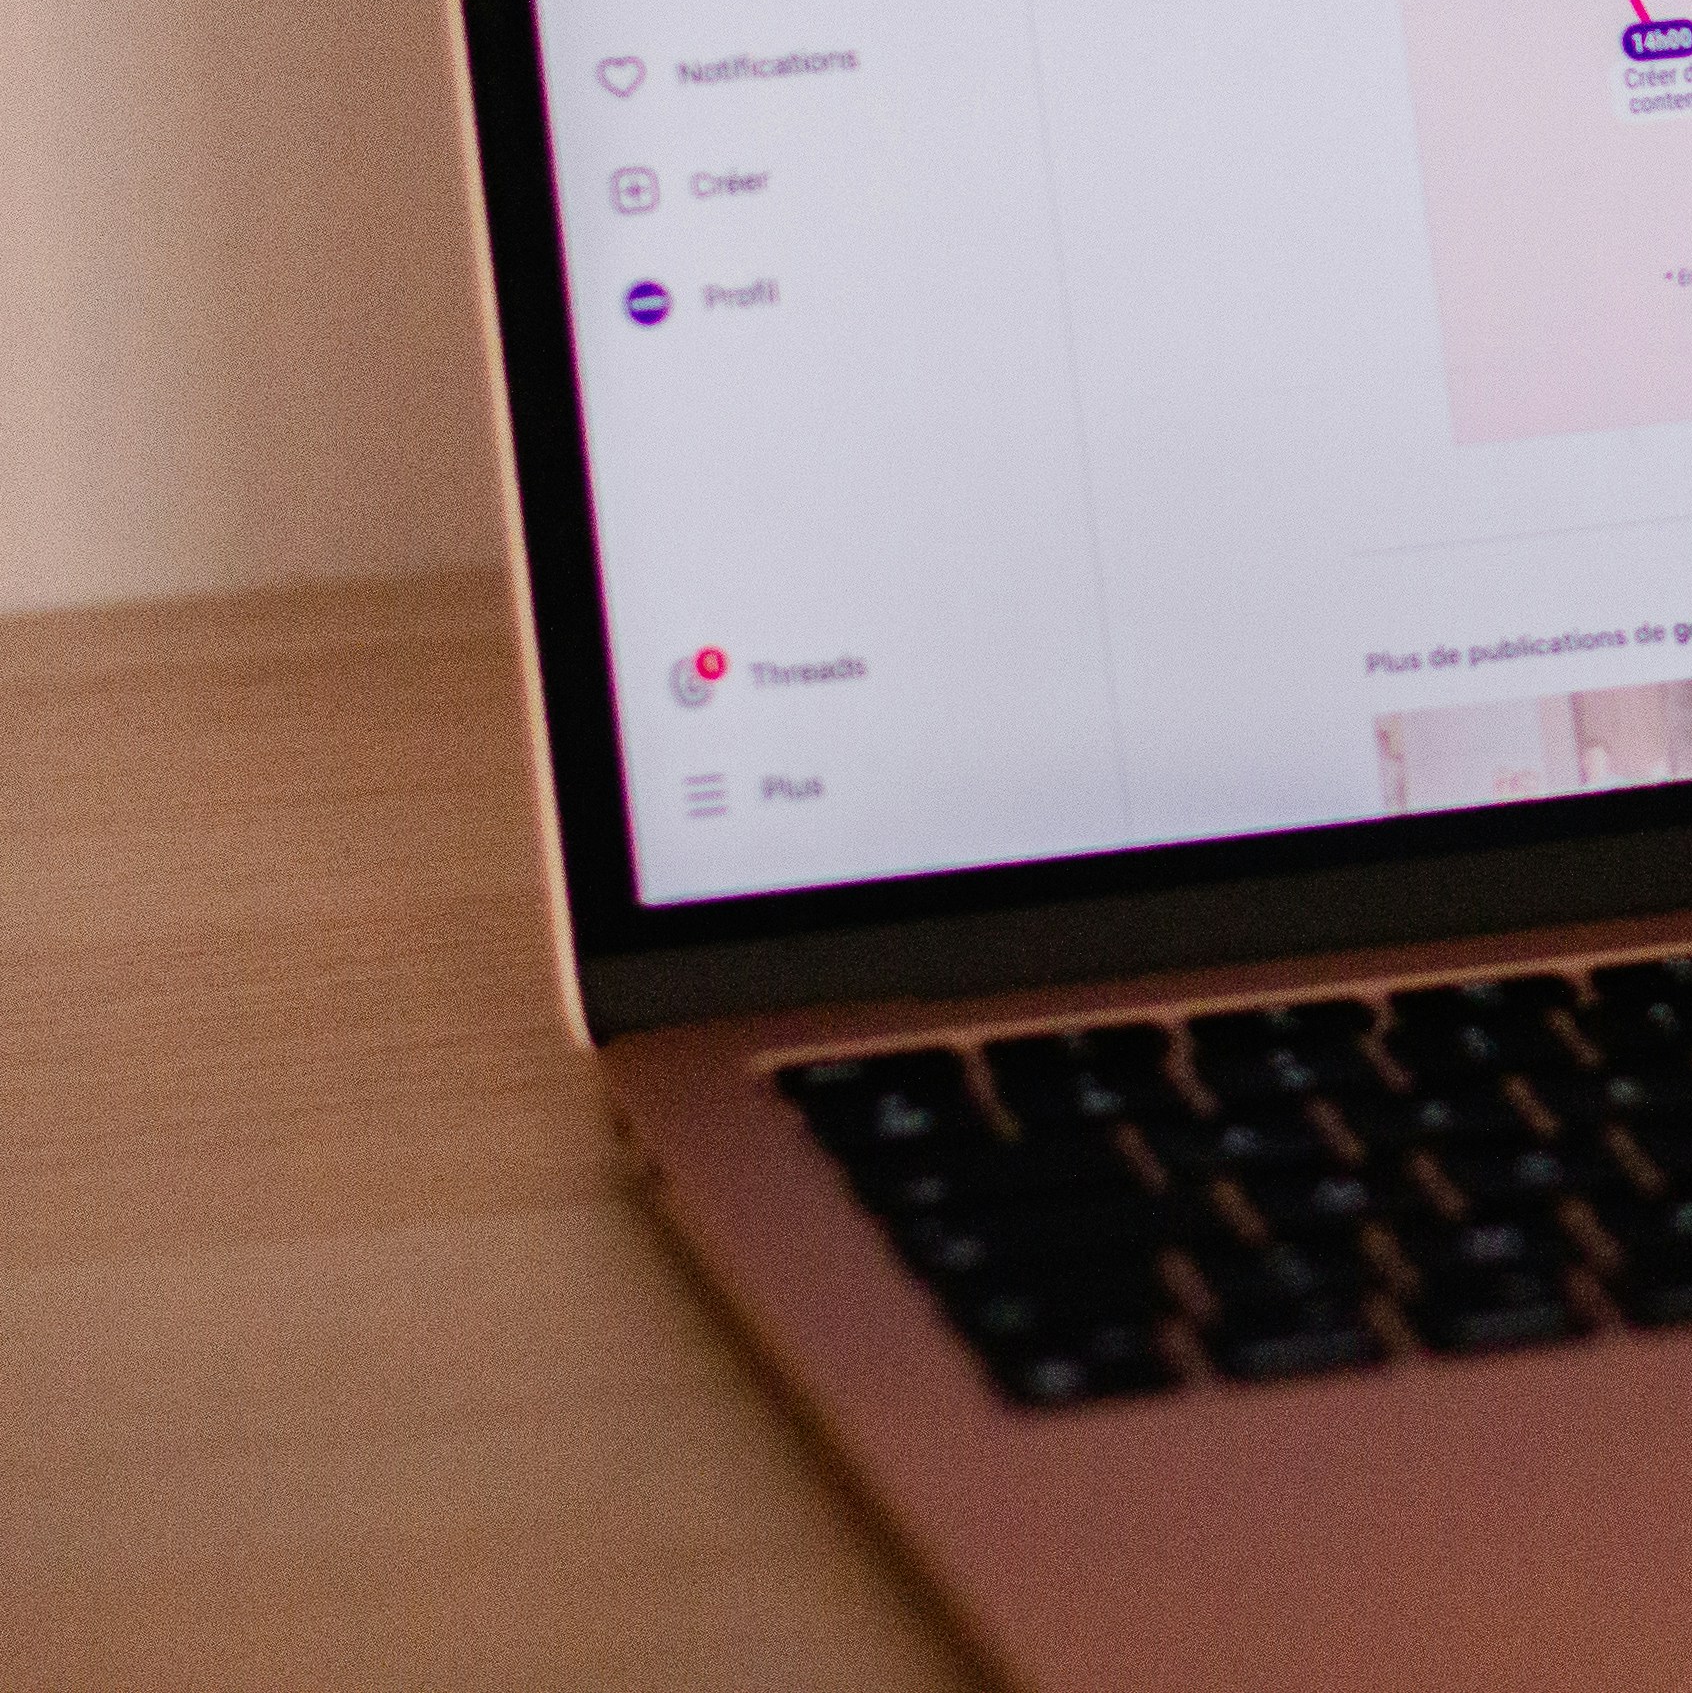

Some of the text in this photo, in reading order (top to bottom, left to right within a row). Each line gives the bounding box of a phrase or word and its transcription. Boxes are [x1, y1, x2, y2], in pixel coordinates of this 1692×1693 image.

[676, 50, 859, 85] Notifications
[1623, 66, 1677, 90] Créer
[692, 172, 769, 199] Créer
[702, 279, 780, 309] Profil
[1365, 652, 1423, 674] Plus
[1427, 646, 1462, 670] de
[1467, 629, 1629, 668] publications
[1634, 623, 1667, 645] de
[751, 657, 868, 686] Threads
[761, 776, 825, 801] Plus
